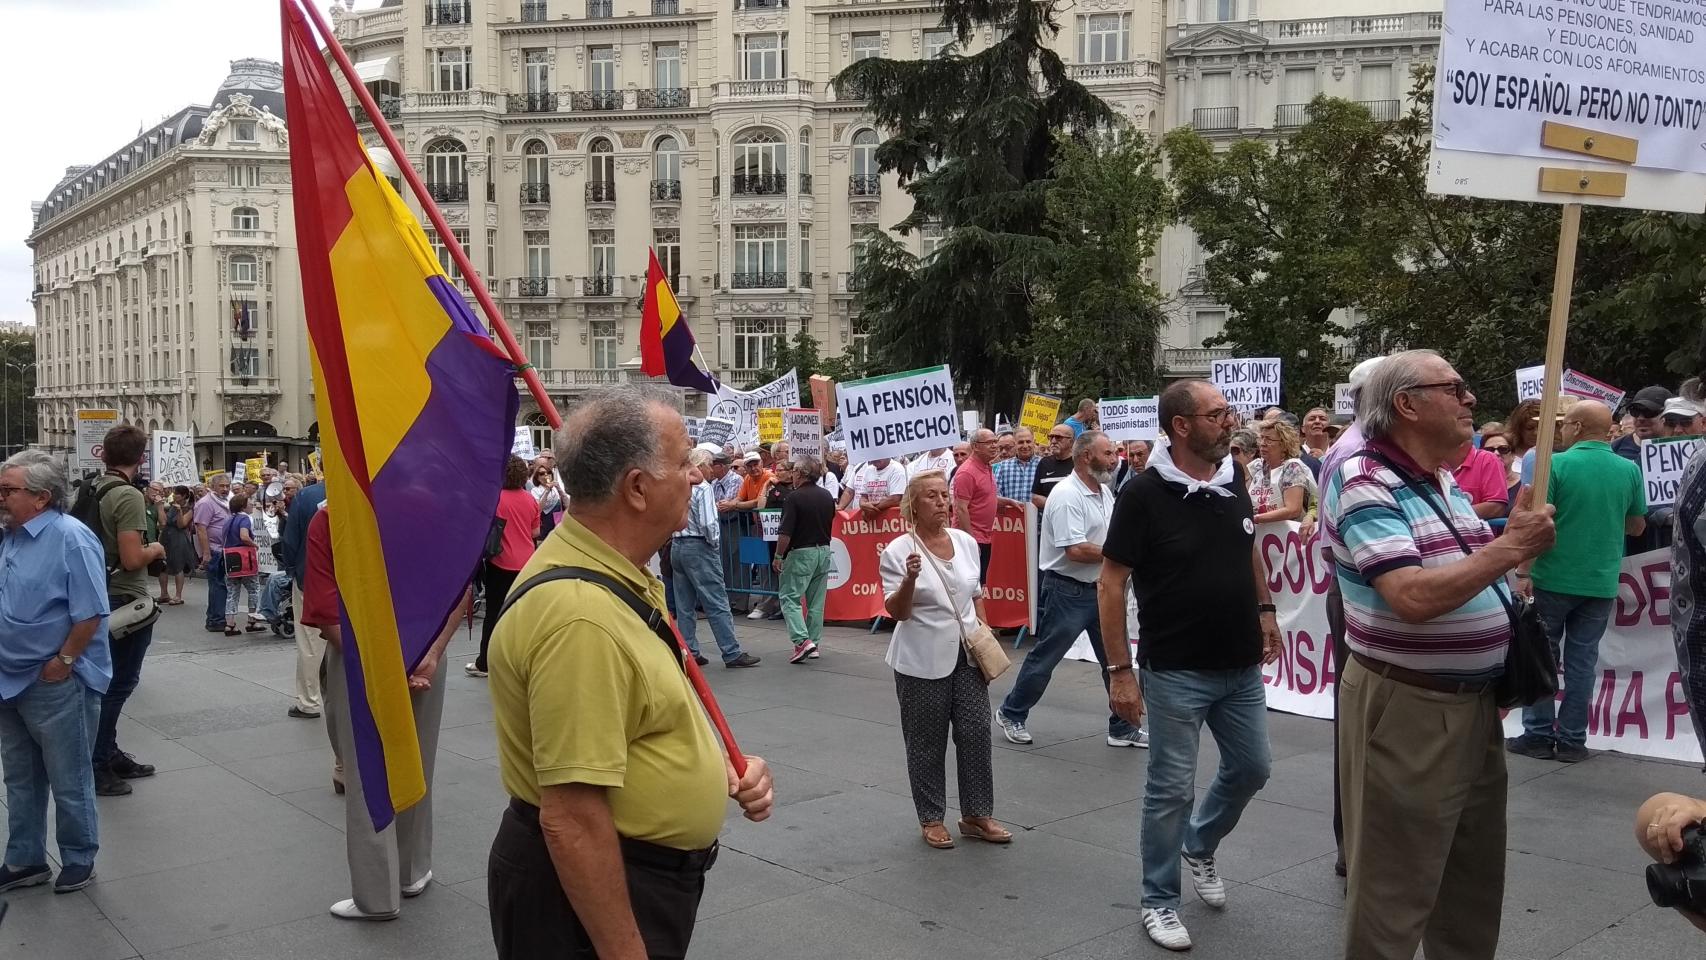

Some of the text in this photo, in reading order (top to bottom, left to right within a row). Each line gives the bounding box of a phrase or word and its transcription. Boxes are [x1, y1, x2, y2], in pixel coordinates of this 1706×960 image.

[1599, 0, 1626, 13] QUE
[1484, 0, 1694, 44] PARA LAS PENSIONES, SANIDAD
[1547, 27, 1637, 55] Y EDUCACIÓN
[1465, 37, 1705, 84] Y ACABAR CON LOS AFORAMIENTOS
[1494, 73, 1572, 116] ESPAÑOL
[1577, 85, 1623, 121] PERO
[1625, 91, 1650, 124] NO
[1214, 360, 1278, 384] PENSIONES
[845, 380, 952, 418] LA PENSIÓN,
[1222, 386, 1252, 402] IGNAS
[1520, 378, 1544, 401] ¡PENS
[1102, 404, 1157, 416] TODOS somos
[850, 414, 956, 450] MI DERECHO!
[1102, 417, 1158, 432] pensionistas!!!
[811, 431, 820, 441] mi
[771, 514, 782, 523] PEN
[991, 516, 1025, 533] ADA
[852, 583, 1025, 602] CON ADOS
